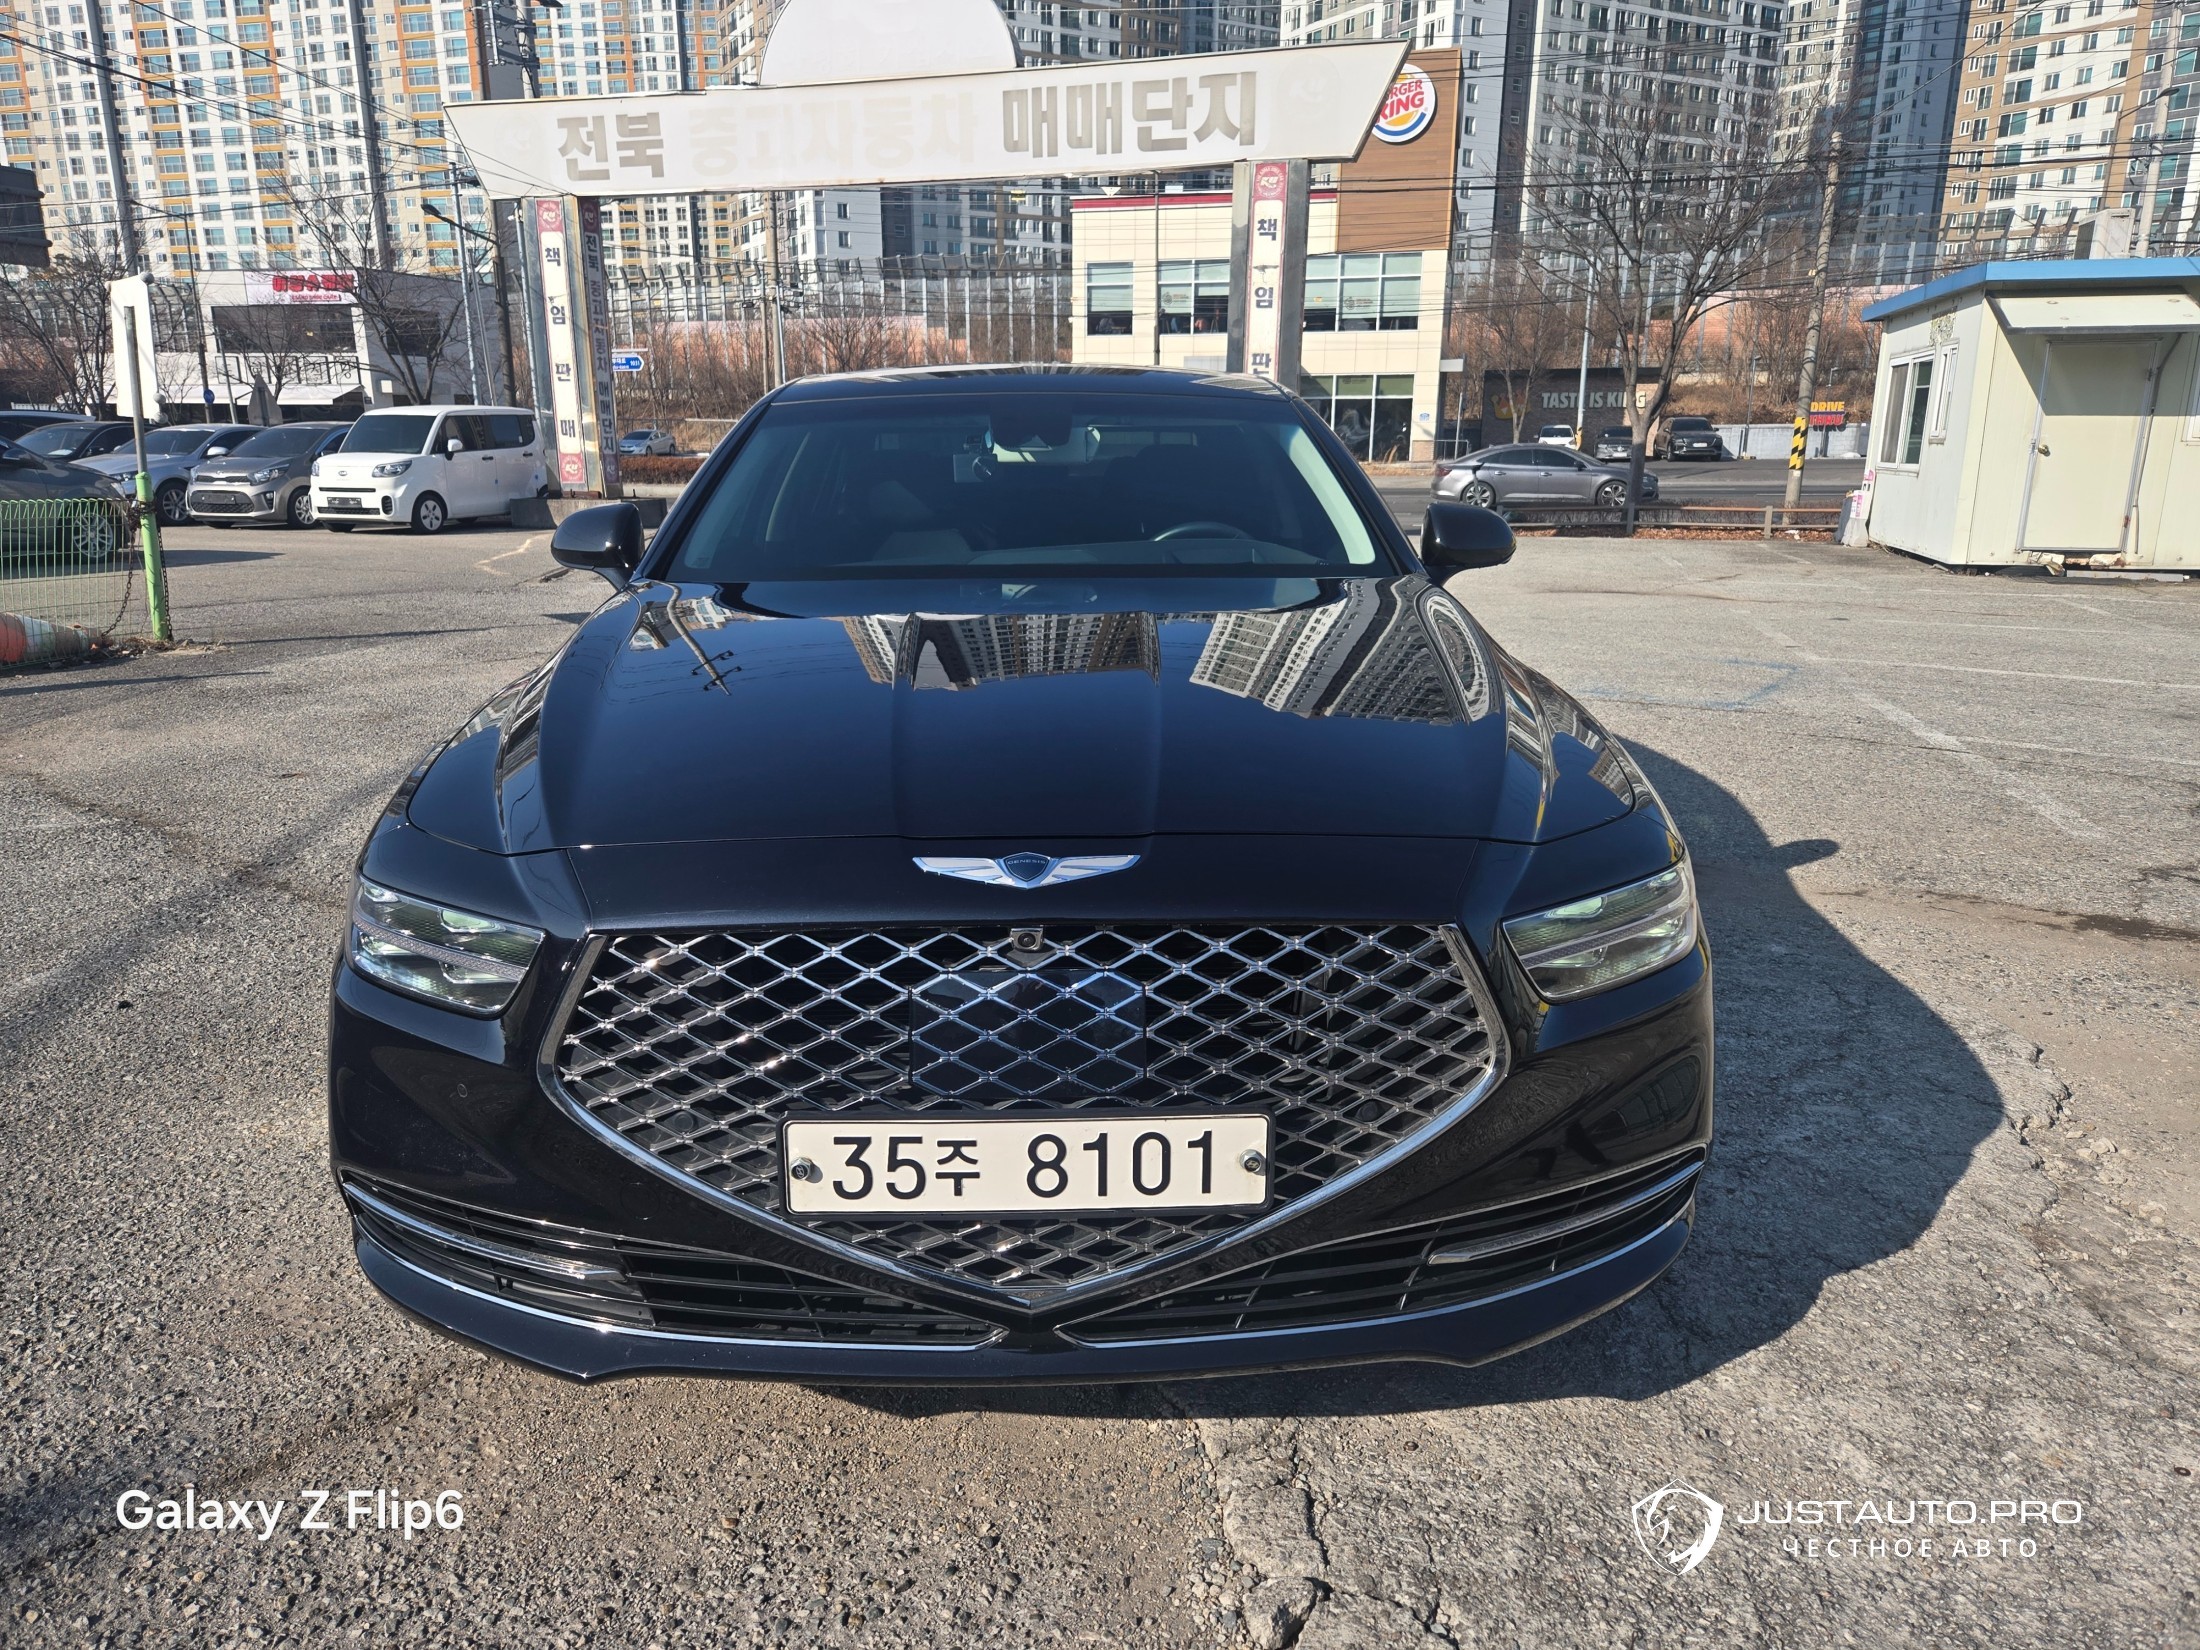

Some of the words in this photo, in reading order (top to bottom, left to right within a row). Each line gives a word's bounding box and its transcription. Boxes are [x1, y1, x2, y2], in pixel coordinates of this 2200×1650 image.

[1389, 79, 1423, 100] RGER
[556, 111, 665, 181] 전북
[689, 92, 978, 176] 중고자동차
[1002, 71, 1258, 158] 매매단지
[544, 247, 576, 438] 책임판매
[585, 235, 599, 271] 전북
[598, 381, 614, 452] 매매단지
[1589, 392, 1603, 408] IS
[1810, 401, 1845, 412] DRIVE
[832, 1135, 981, 1200] 35주
[1026, 1130, 1214, 1198] 8101
